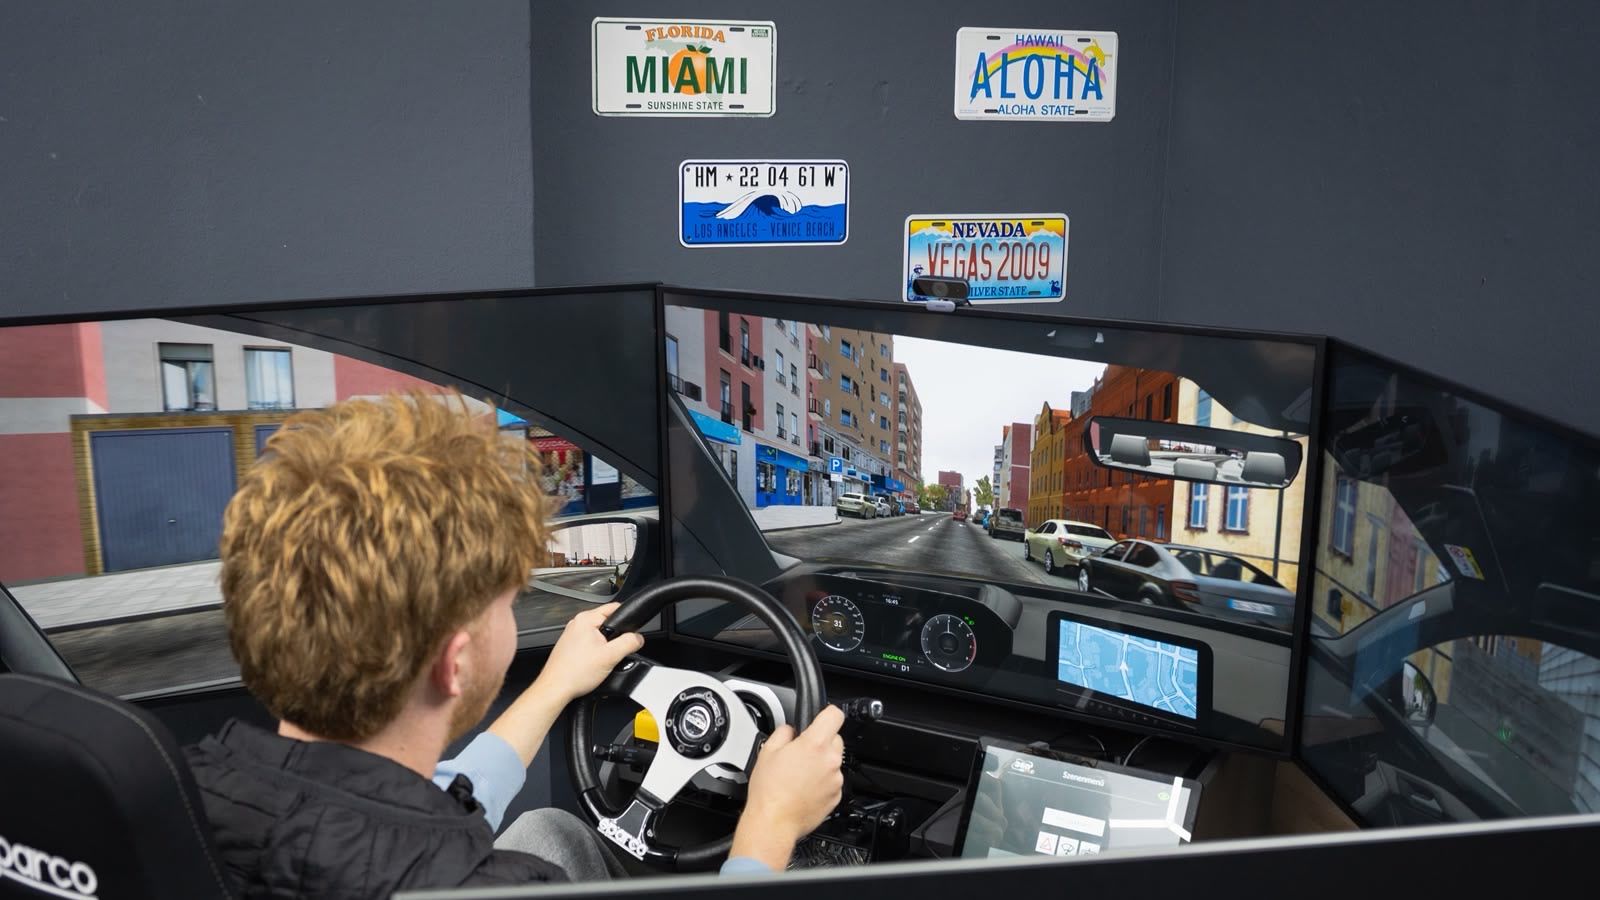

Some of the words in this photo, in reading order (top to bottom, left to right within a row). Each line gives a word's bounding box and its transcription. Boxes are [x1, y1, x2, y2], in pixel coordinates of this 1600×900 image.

[645, 25, 726, 43] FLORIDA
[1015, 34, 1063, 47] HAWAII
[626, 55, 748, 94] MIAMI
[969, 52, 1103, 101] ALOHA
[647, 101, 694, 110] SUNSHINE
[696, 101, 723, 110] STATE
[997, 104, 1036, 115] ALOHA
[1041, 105, 1075, 116] STATE
[695, 166, 718, 187] HM
[739, 166, 759, 187] 22
[768, 166, 788, 187] 04
[824, 166, 836, 187] W
[694, 224, 713, 239] LOS
[716, 223, 758, 238] ANGELES
[771, 223, 802, 238] VENICE
[806, 222, 835, 237] BEACH
[951, 222, 1026, 238] NEVADA
[927, 242, 992, 281] VEGAS
[997, 242, 1050, 281] 2009
[970, 287, 997, 297] ILVER
[1000, 286, 1027, 296] STATE
[832, 459, 841, 471] P
[833, 620, 843, 628] 31
[901, 664, 910, 672] D1
[1062, 771, 1105, 786] Szenenmenü
[599, 818, 648, 857] sparco
